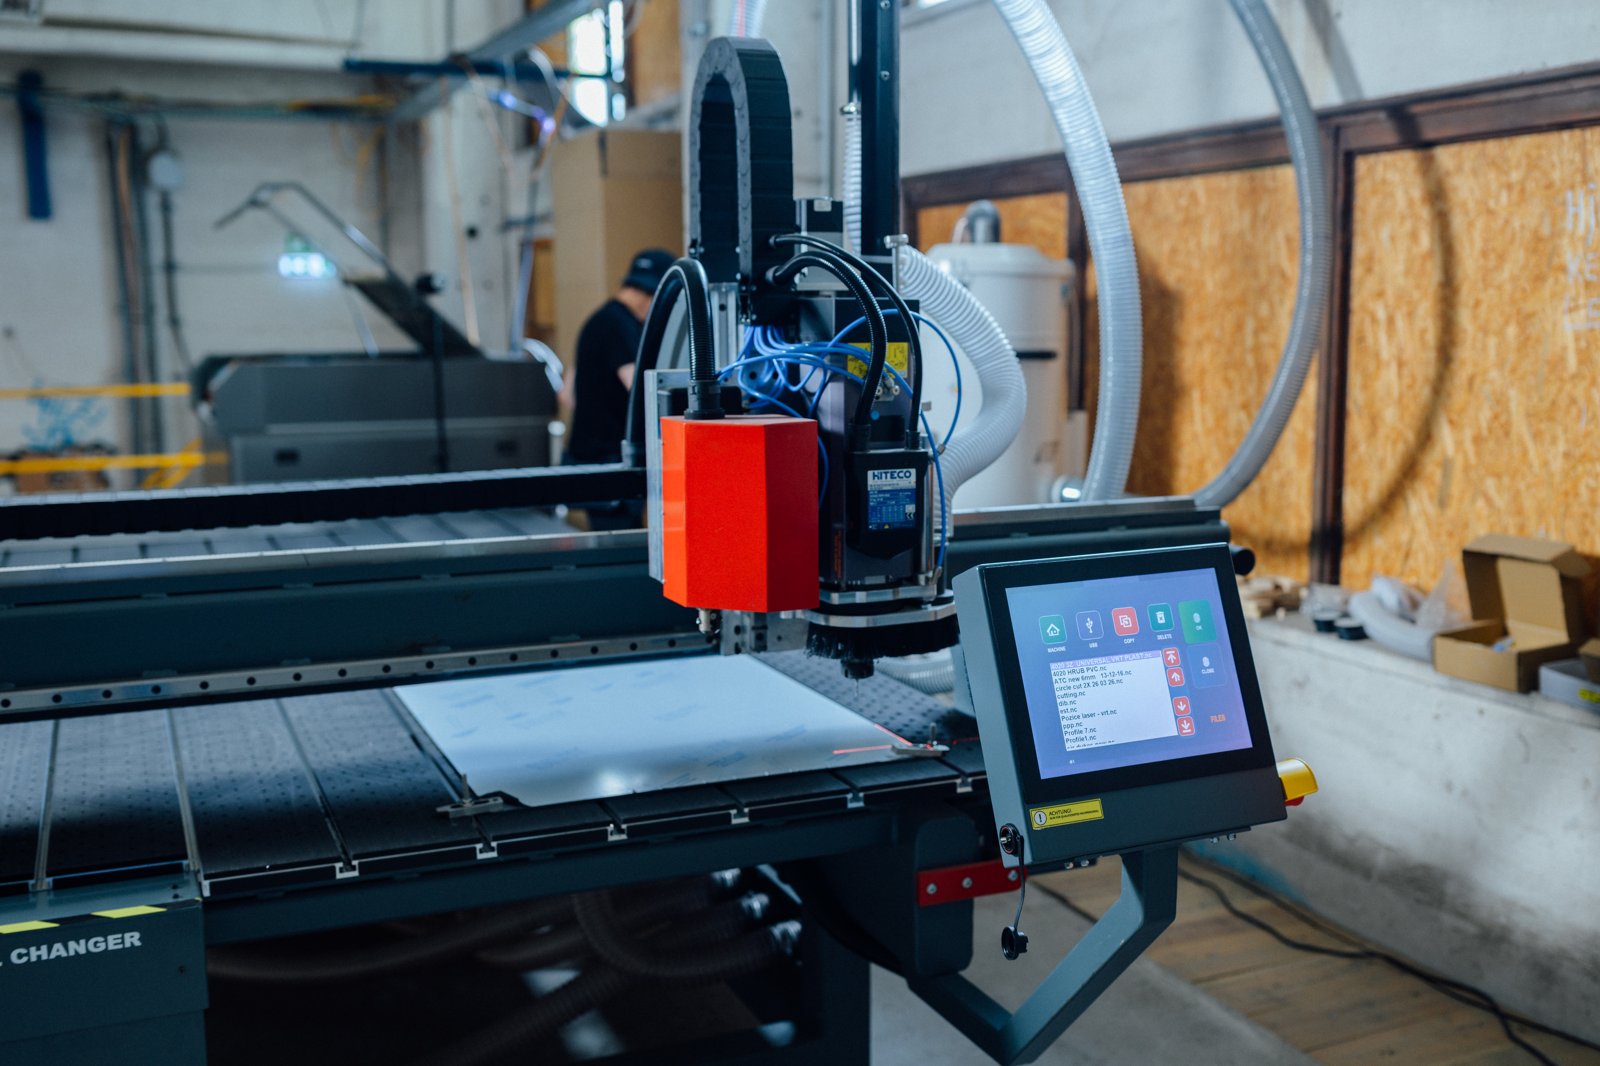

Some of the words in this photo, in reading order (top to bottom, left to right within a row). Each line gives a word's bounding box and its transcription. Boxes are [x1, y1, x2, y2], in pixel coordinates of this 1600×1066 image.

[872, 470, 912, 480] HITECO
[1057, 691, 1086, 700] cutting.nc
[1063, 722, 1083, 730] ppp.nc
[1066, 735, 1097, 744] Profile1.nc
[10, 931, 142, 964] CHANGER
